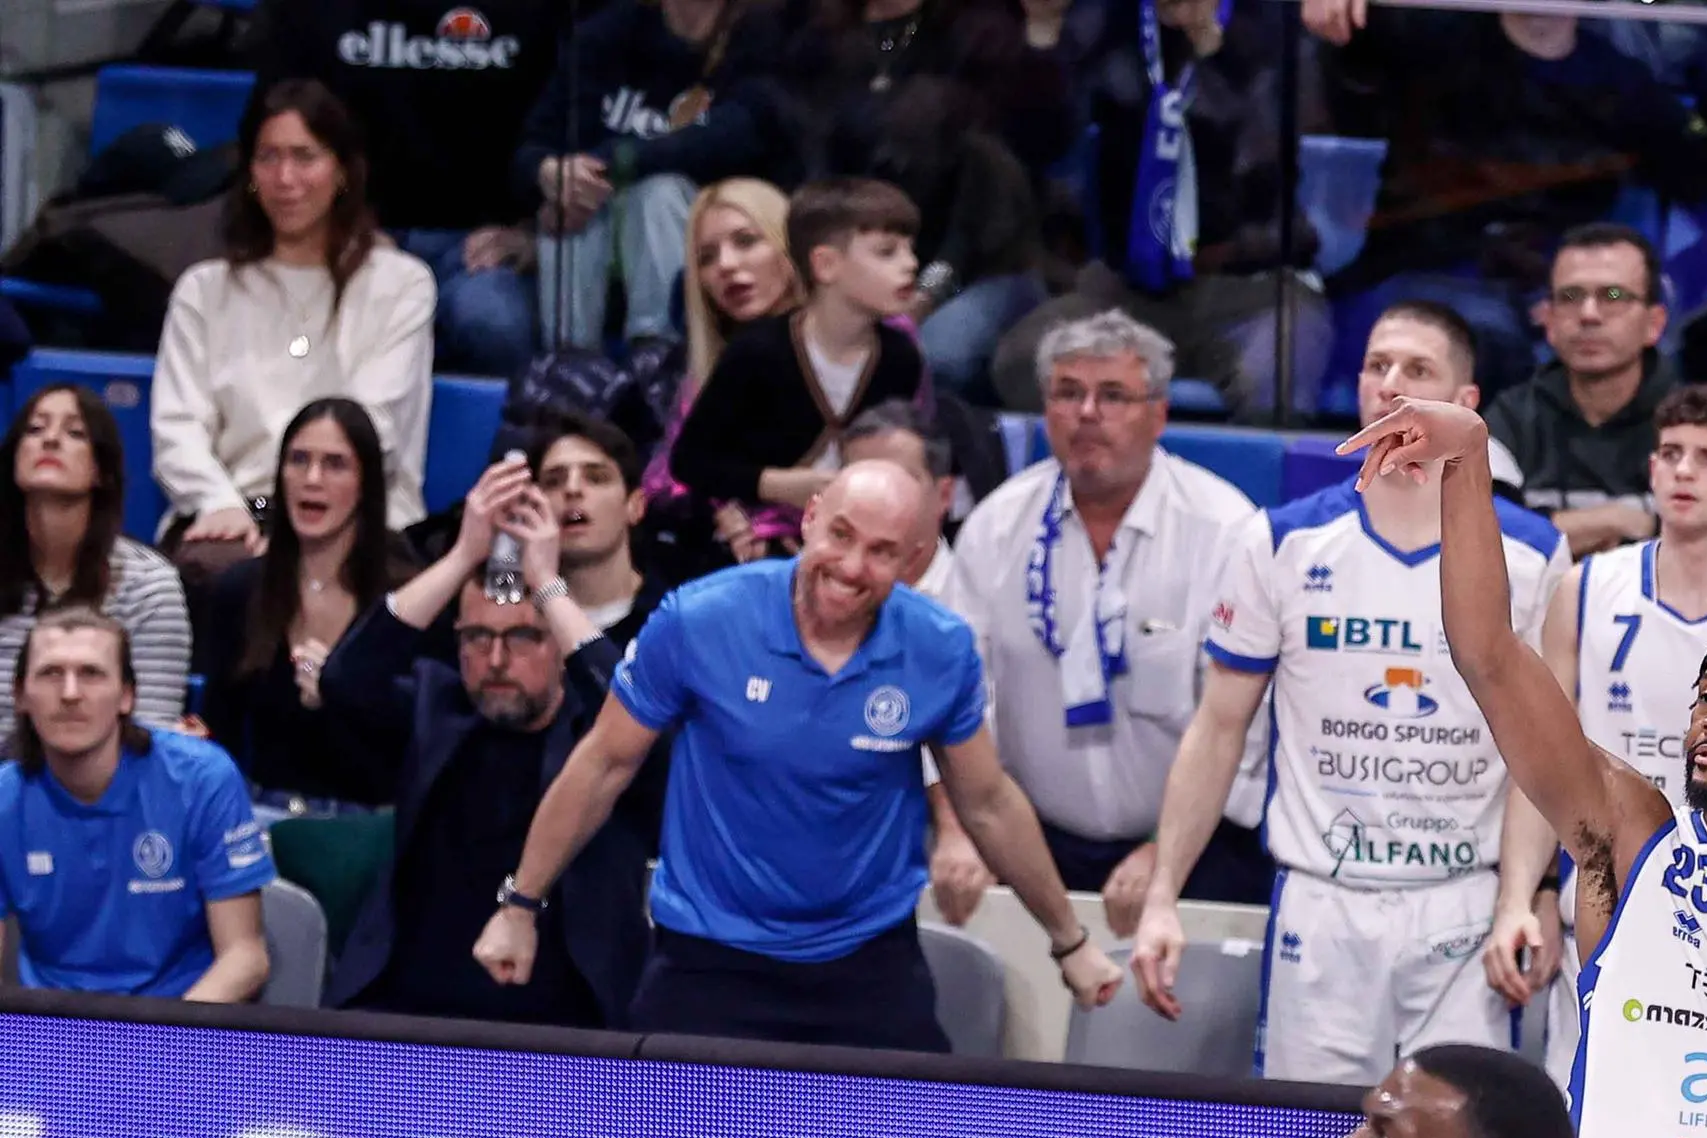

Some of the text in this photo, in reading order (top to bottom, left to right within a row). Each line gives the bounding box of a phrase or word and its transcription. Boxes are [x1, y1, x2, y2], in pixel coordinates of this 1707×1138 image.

[337, 22, 521, 71] ellesse
[1344, 617, 1423, 651] BTL
[1609, 614, 1642, 672] 7
[1321, 718, 1481, 746] BORGO SPURGHI
[1621, 727, 1686, 759] TEC
[1318, 751, 1490, 786] BUSIGROUP
[1386, 811, 1459, 834] Gruppo
[1331, 824, 1475, 877] ALFANO
